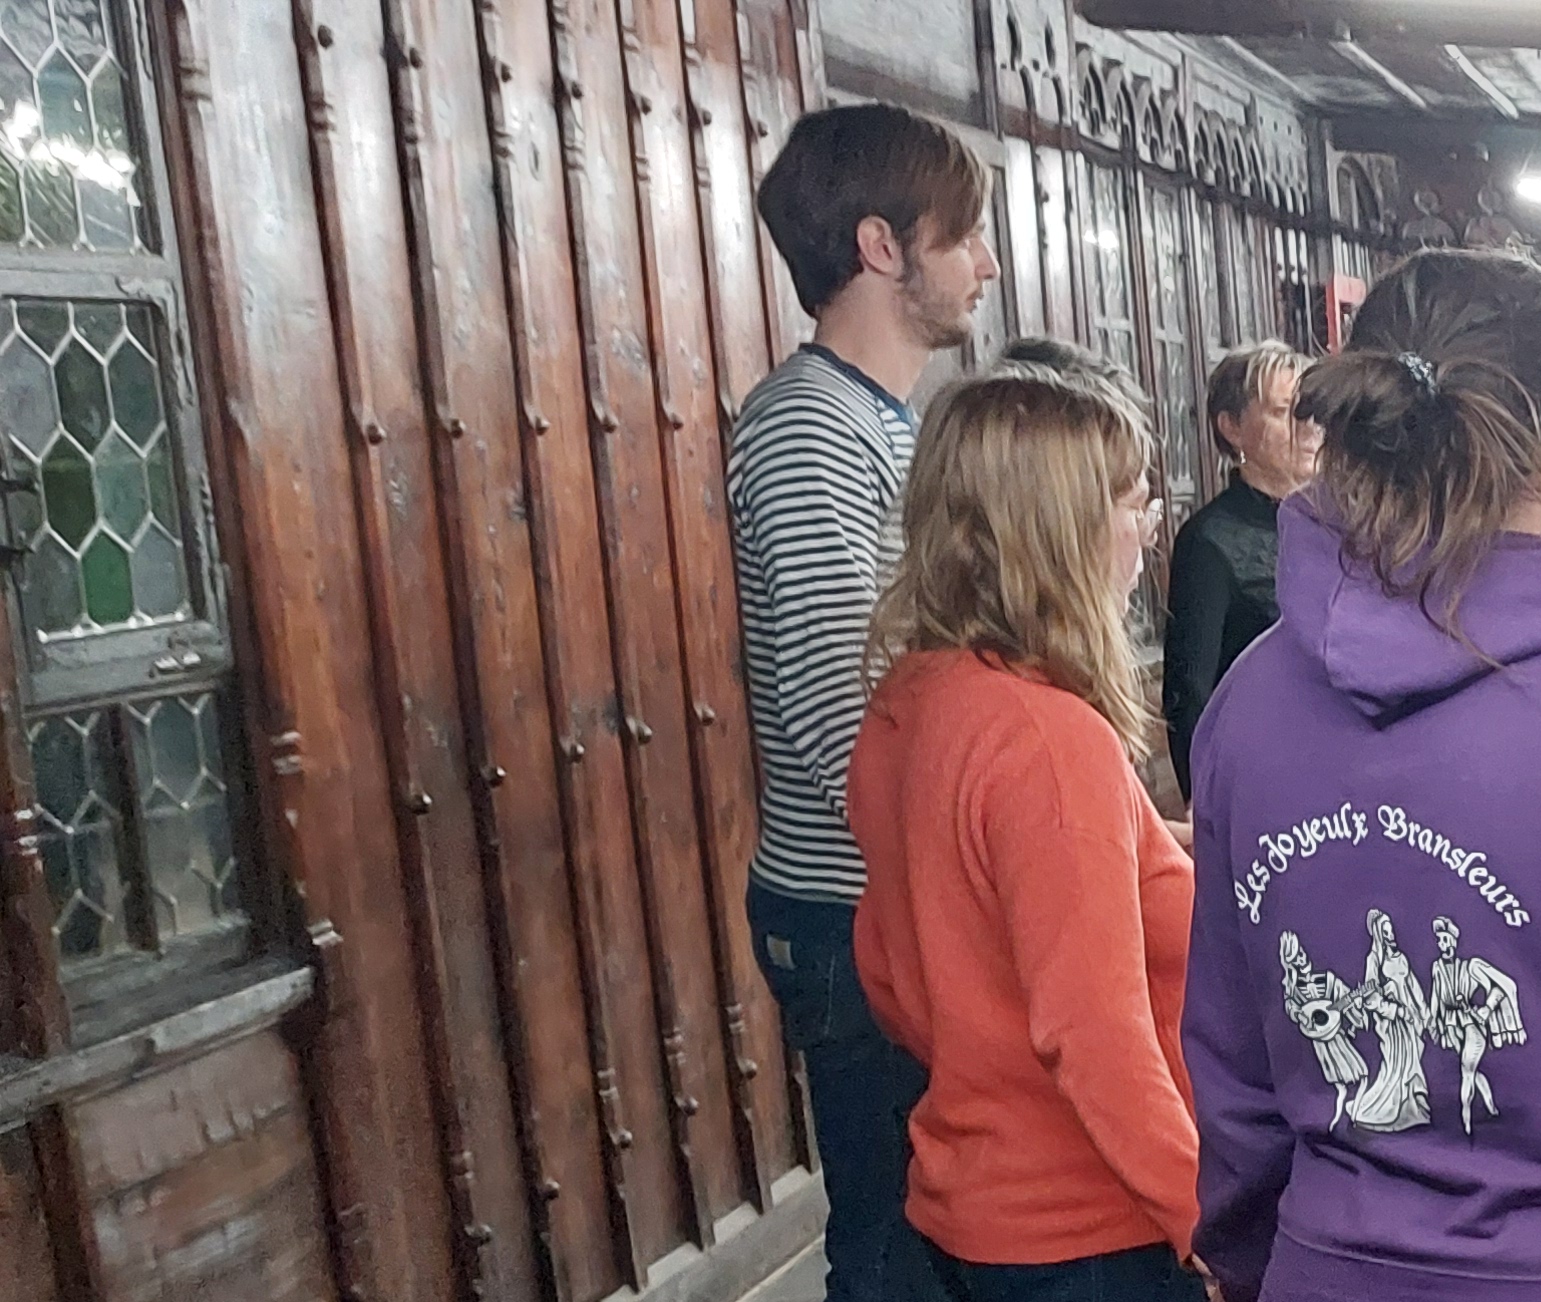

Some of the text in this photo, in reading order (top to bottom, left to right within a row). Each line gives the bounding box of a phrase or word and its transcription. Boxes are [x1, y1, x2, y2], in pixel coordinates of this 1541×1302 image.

[1234, 802, 1531, 928] Les Joyeulx Bransleurs
